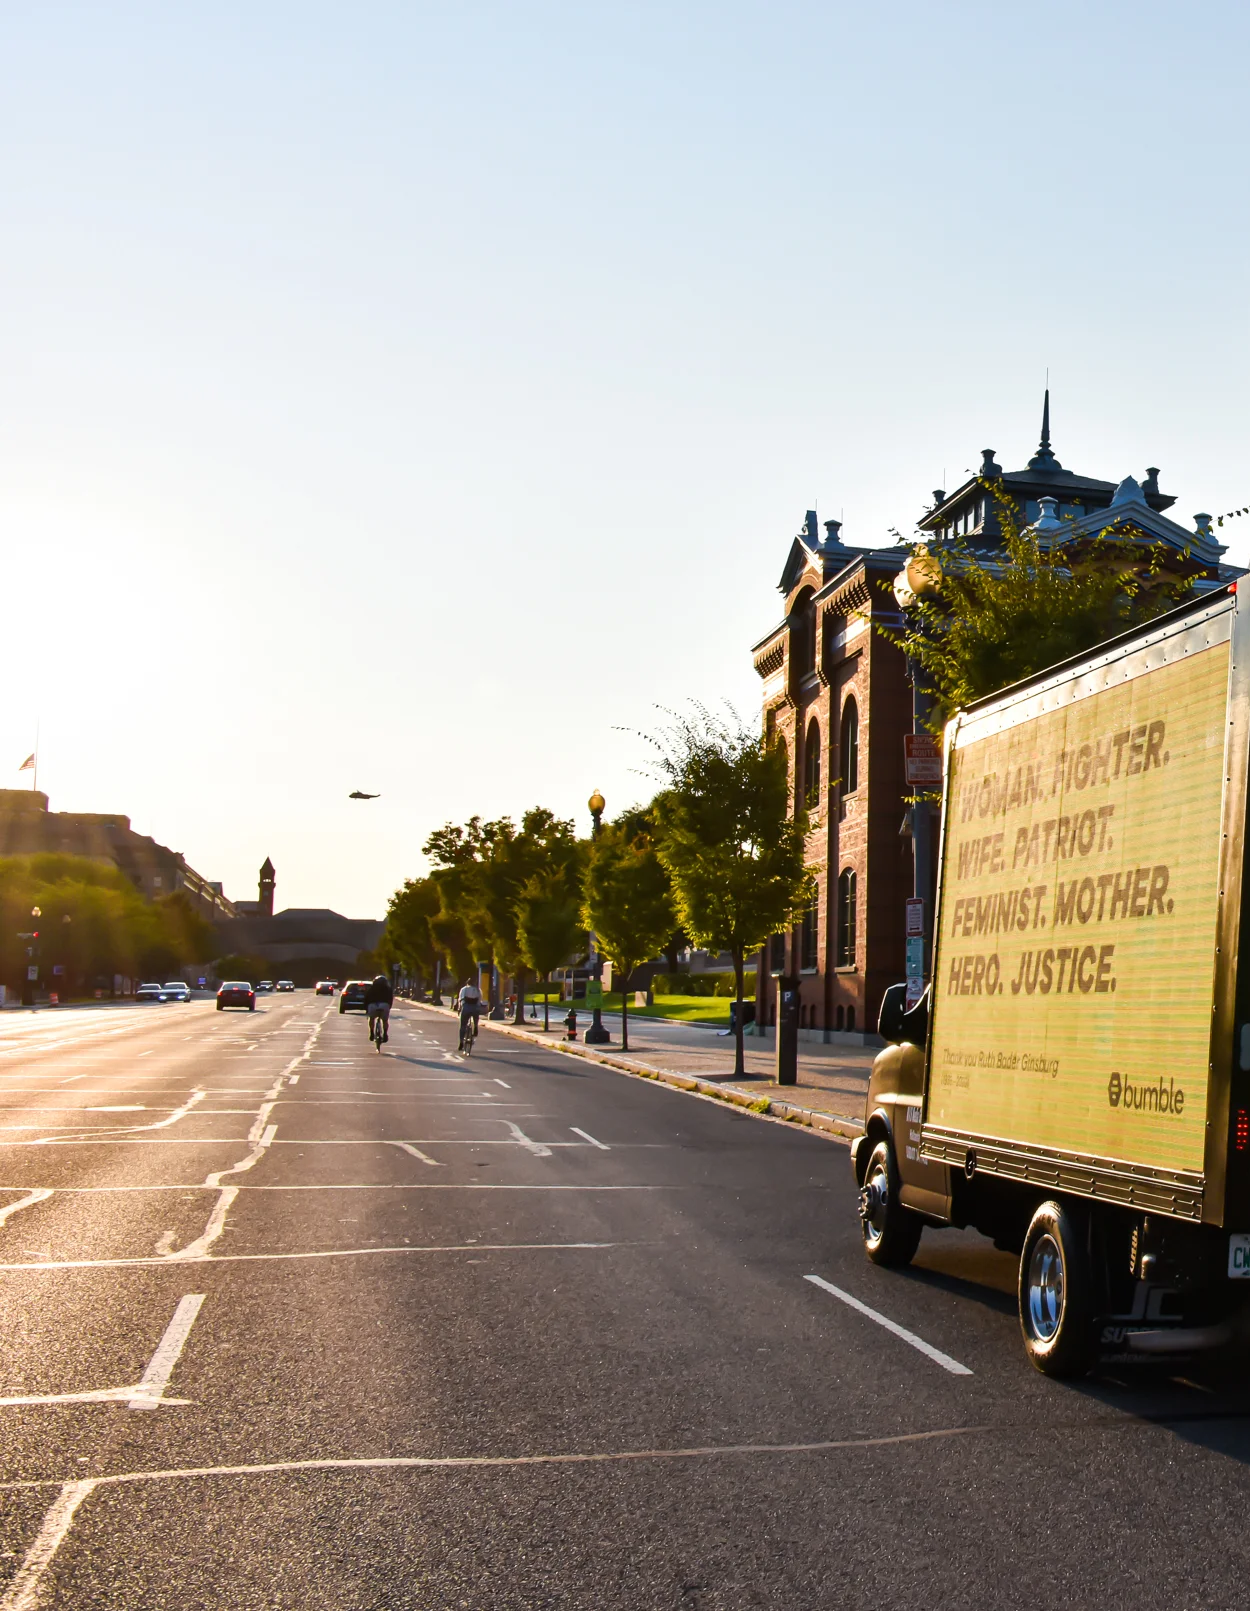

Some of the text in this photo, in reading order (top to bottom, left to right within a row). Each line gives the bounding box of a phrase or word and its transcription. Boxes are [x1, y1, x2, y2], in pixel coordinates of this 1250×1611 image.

[912, 749, 936, 757] ROUTE
[960, 719, 1170, 824] WOMAN. FIGHTER.
[957, 804, 1115, 881] WIFE. PATRIOT.
[951, 864, 1175, 938] FEMINIST. MOTHER.
[947, 953, 1004, 996] HERO.
[1010, 944, 1117, 996] JUSTICE.
[784, 991, 791, 1002] P
[943, 1047, 1060, 1079] Thank you Ruth Bader Ginsburg
[1123, 1073, 1185, 1115] bumble
